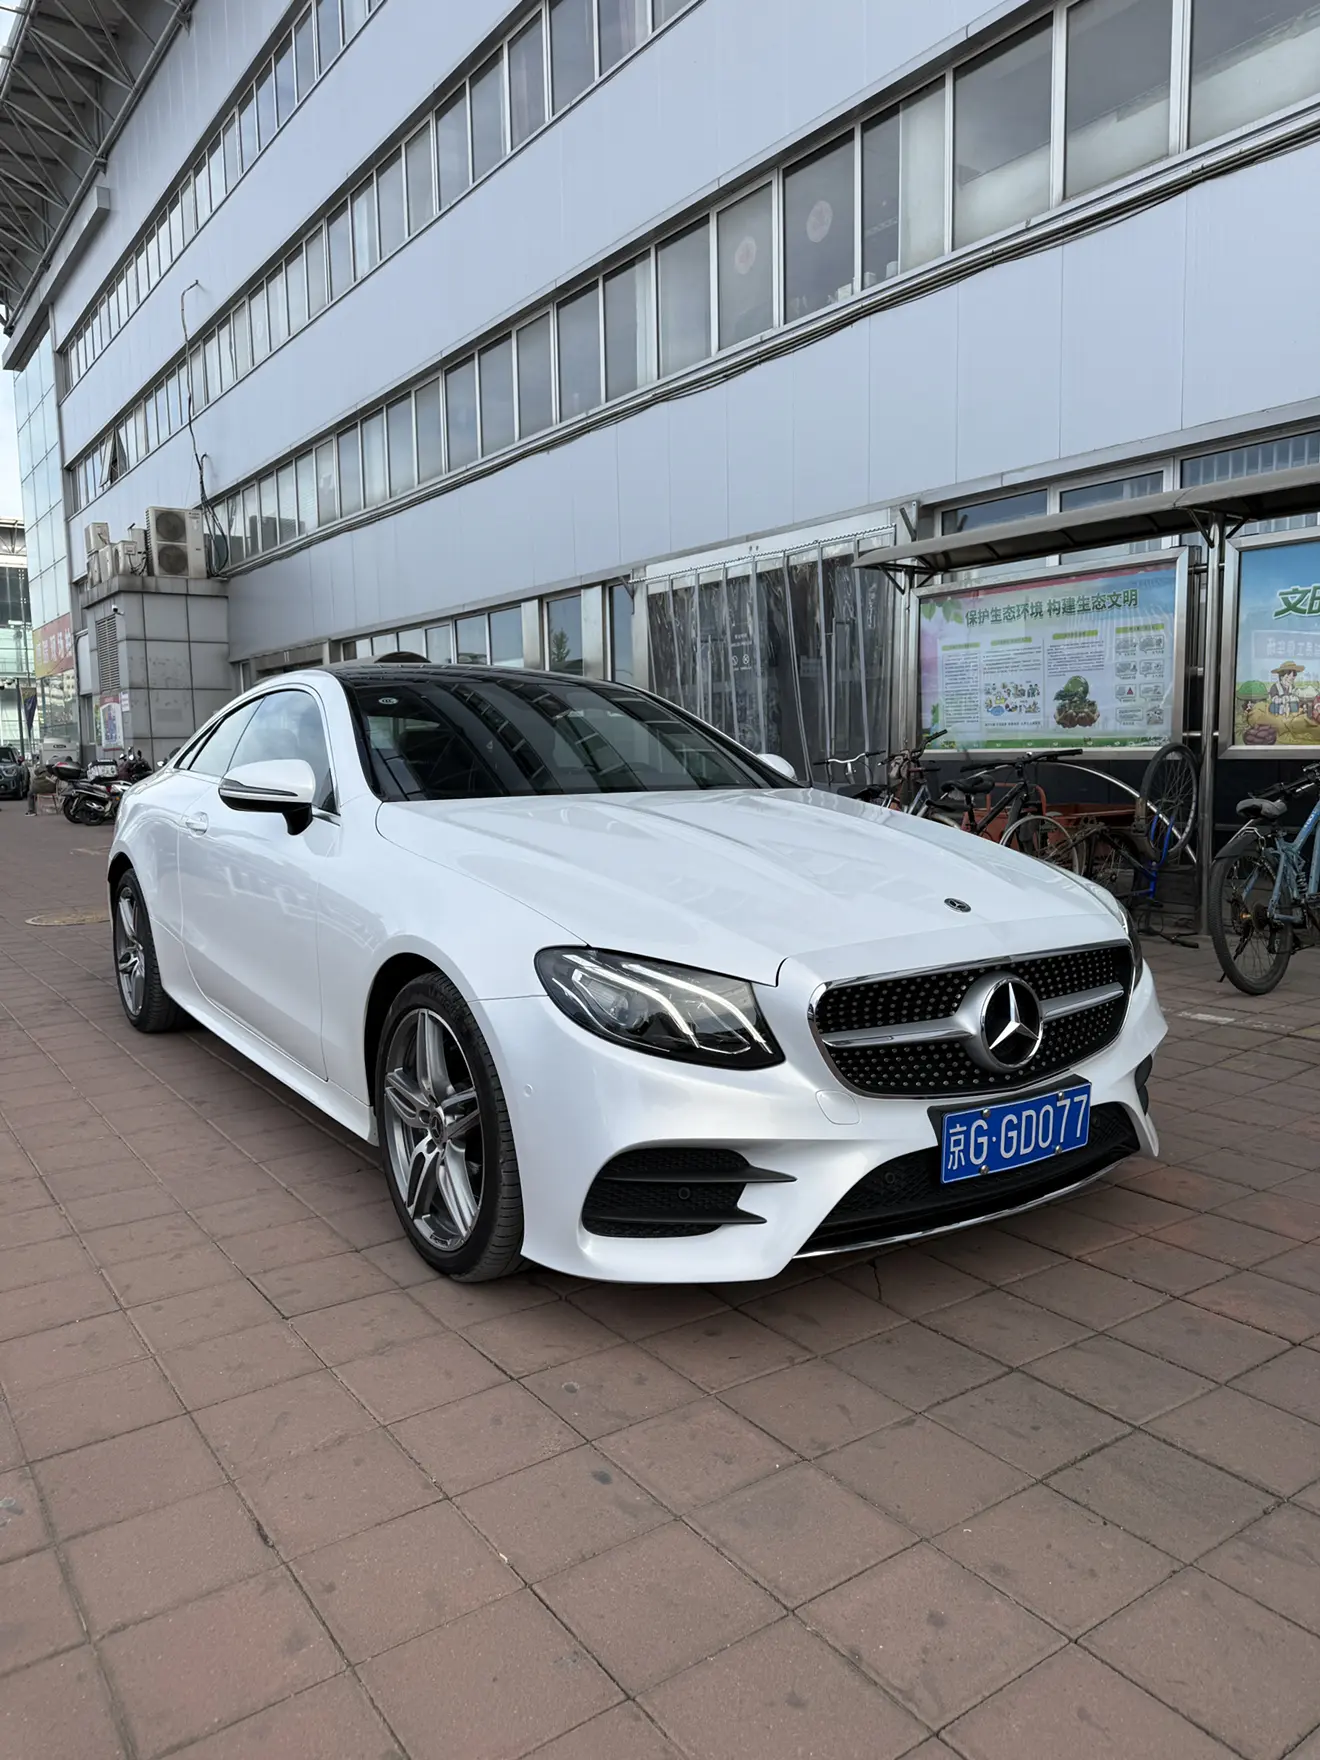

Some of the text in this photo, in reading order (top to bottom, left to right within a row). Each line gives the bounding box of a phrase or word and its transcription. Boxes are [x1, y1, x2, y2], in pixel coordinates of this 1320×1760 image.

[965, 589, 1138, 628] 保护生态环境 构建生态文明
